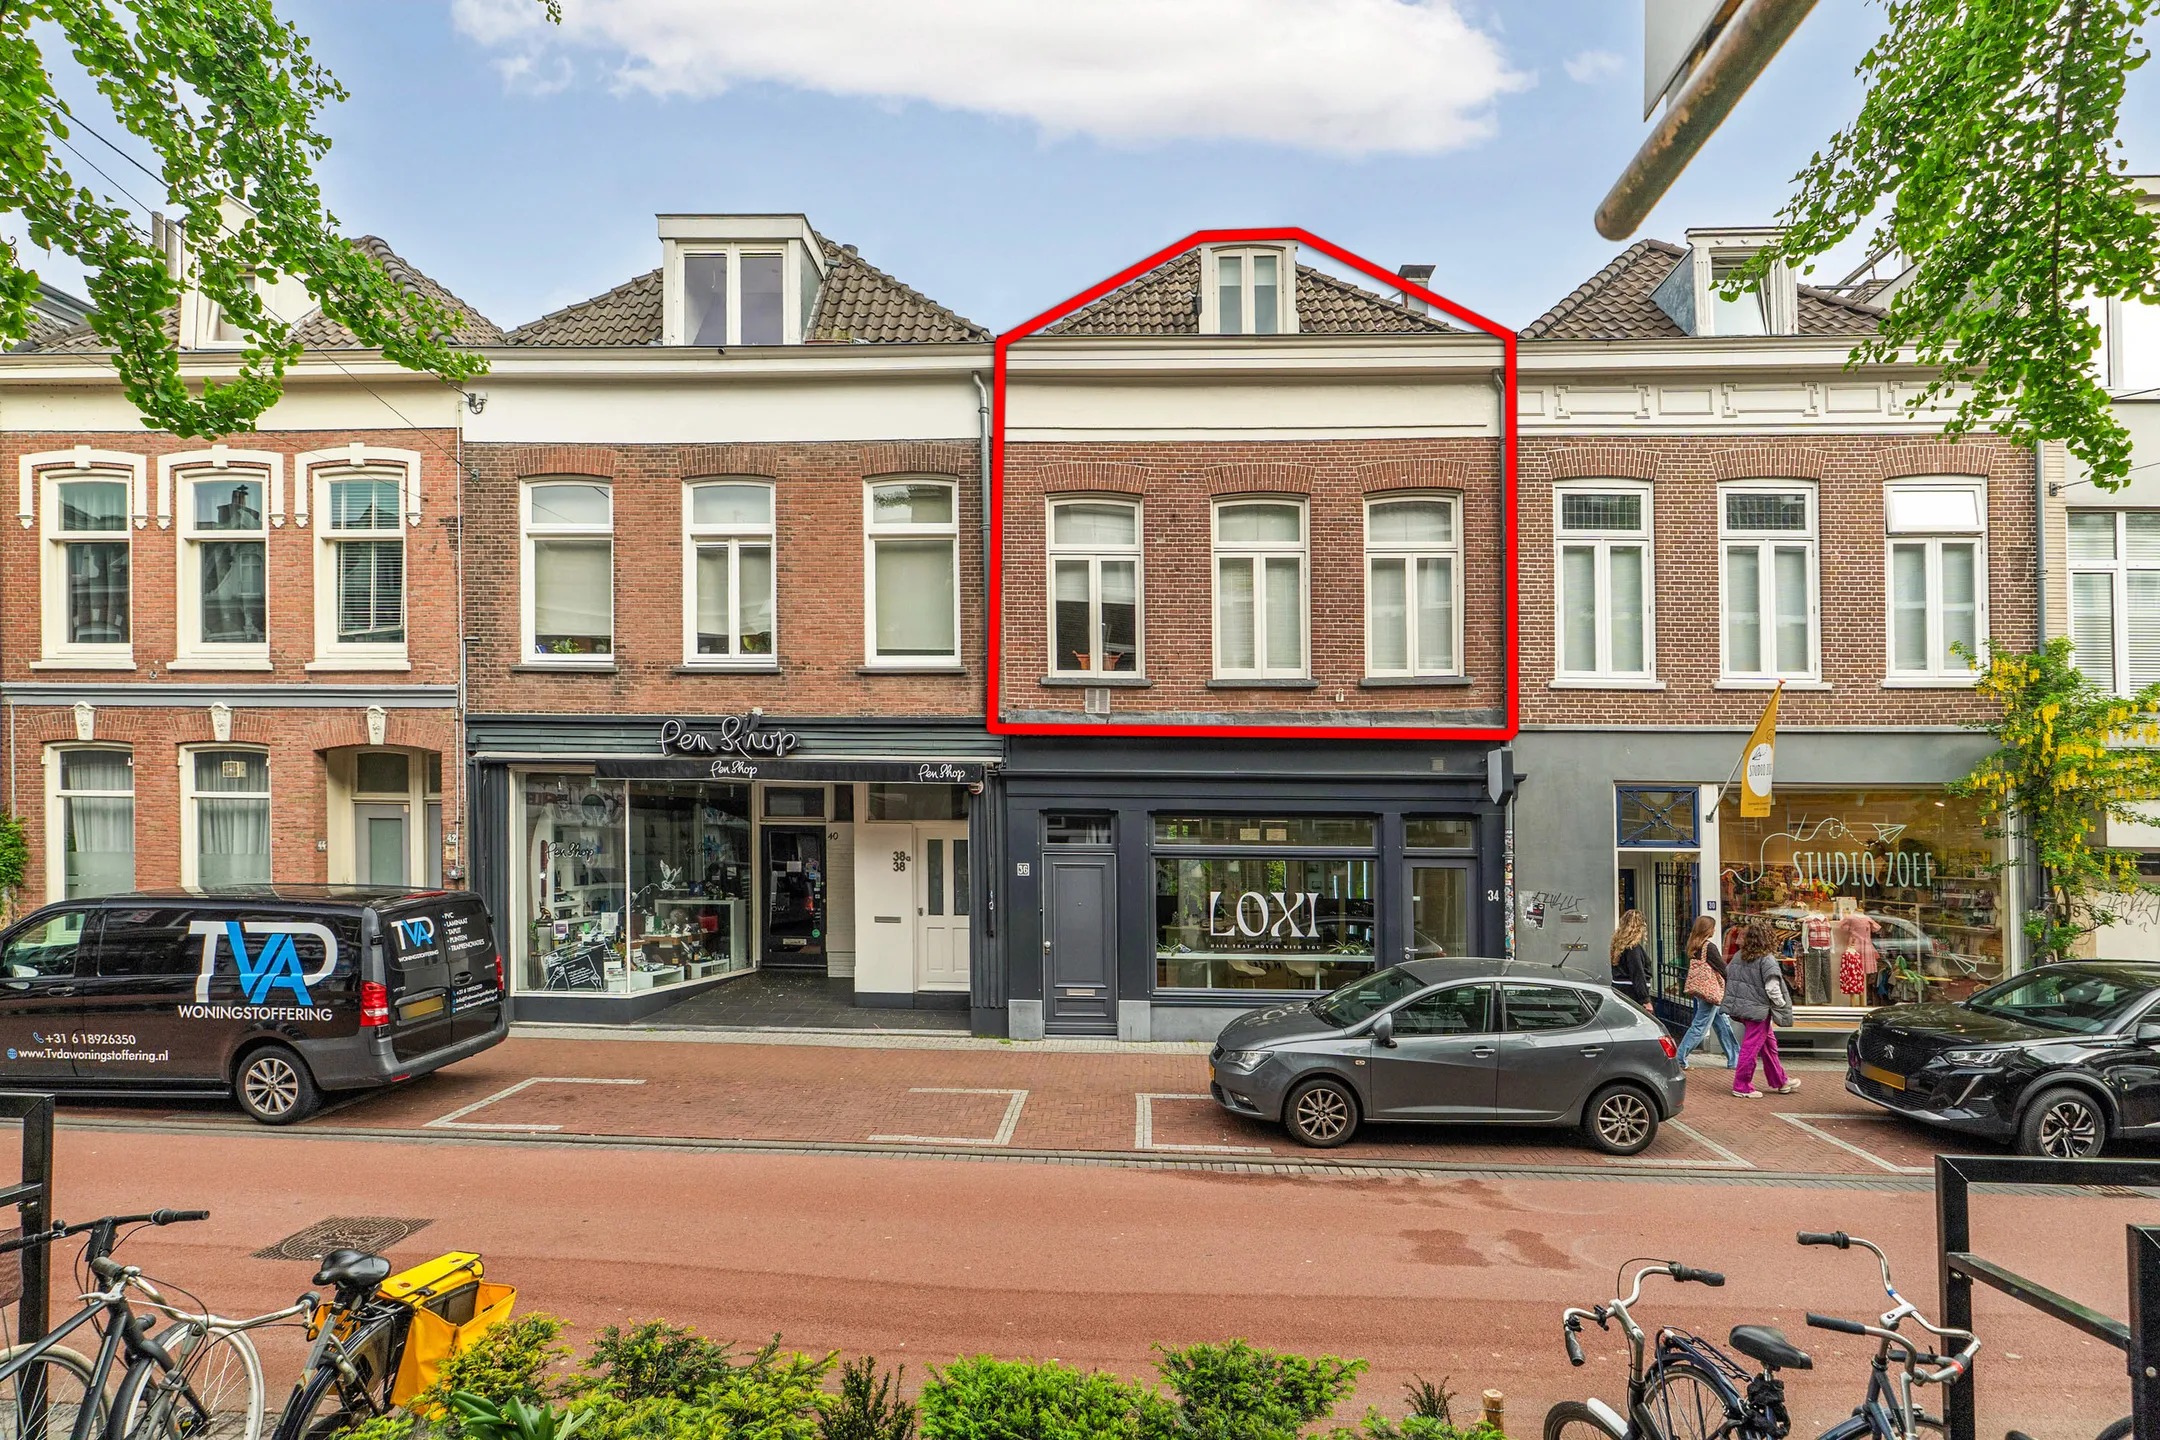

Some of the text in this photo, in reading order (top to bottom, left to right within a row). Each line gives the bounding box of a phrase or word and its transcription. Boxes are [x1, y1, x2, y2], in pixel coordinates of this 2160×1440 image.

[656, 719, 715, 757] Pen
[710, 760, 758, 778] Pen Shop
[918, 763, 966, 782] Pen Shop
[828, 832, 839, 841] 40
[892, 851, 912, 862] 38a
[892, 862, 906, 872] 38
[1018, 865, 1028, 874] 36
[1791, 851, 1933, 888] STUDIO ZOEF
[1487, 889, 1500, 902] 34
[1210, 891, 1321, 938] LOXI
[177, 1005, 333, 1022] WONINGSTOFFERING
[45, 1033, 136, 1045] +31 6 18926350
[18, 1048, 169, 1063] www.Tvdawoningstoffering.nl
